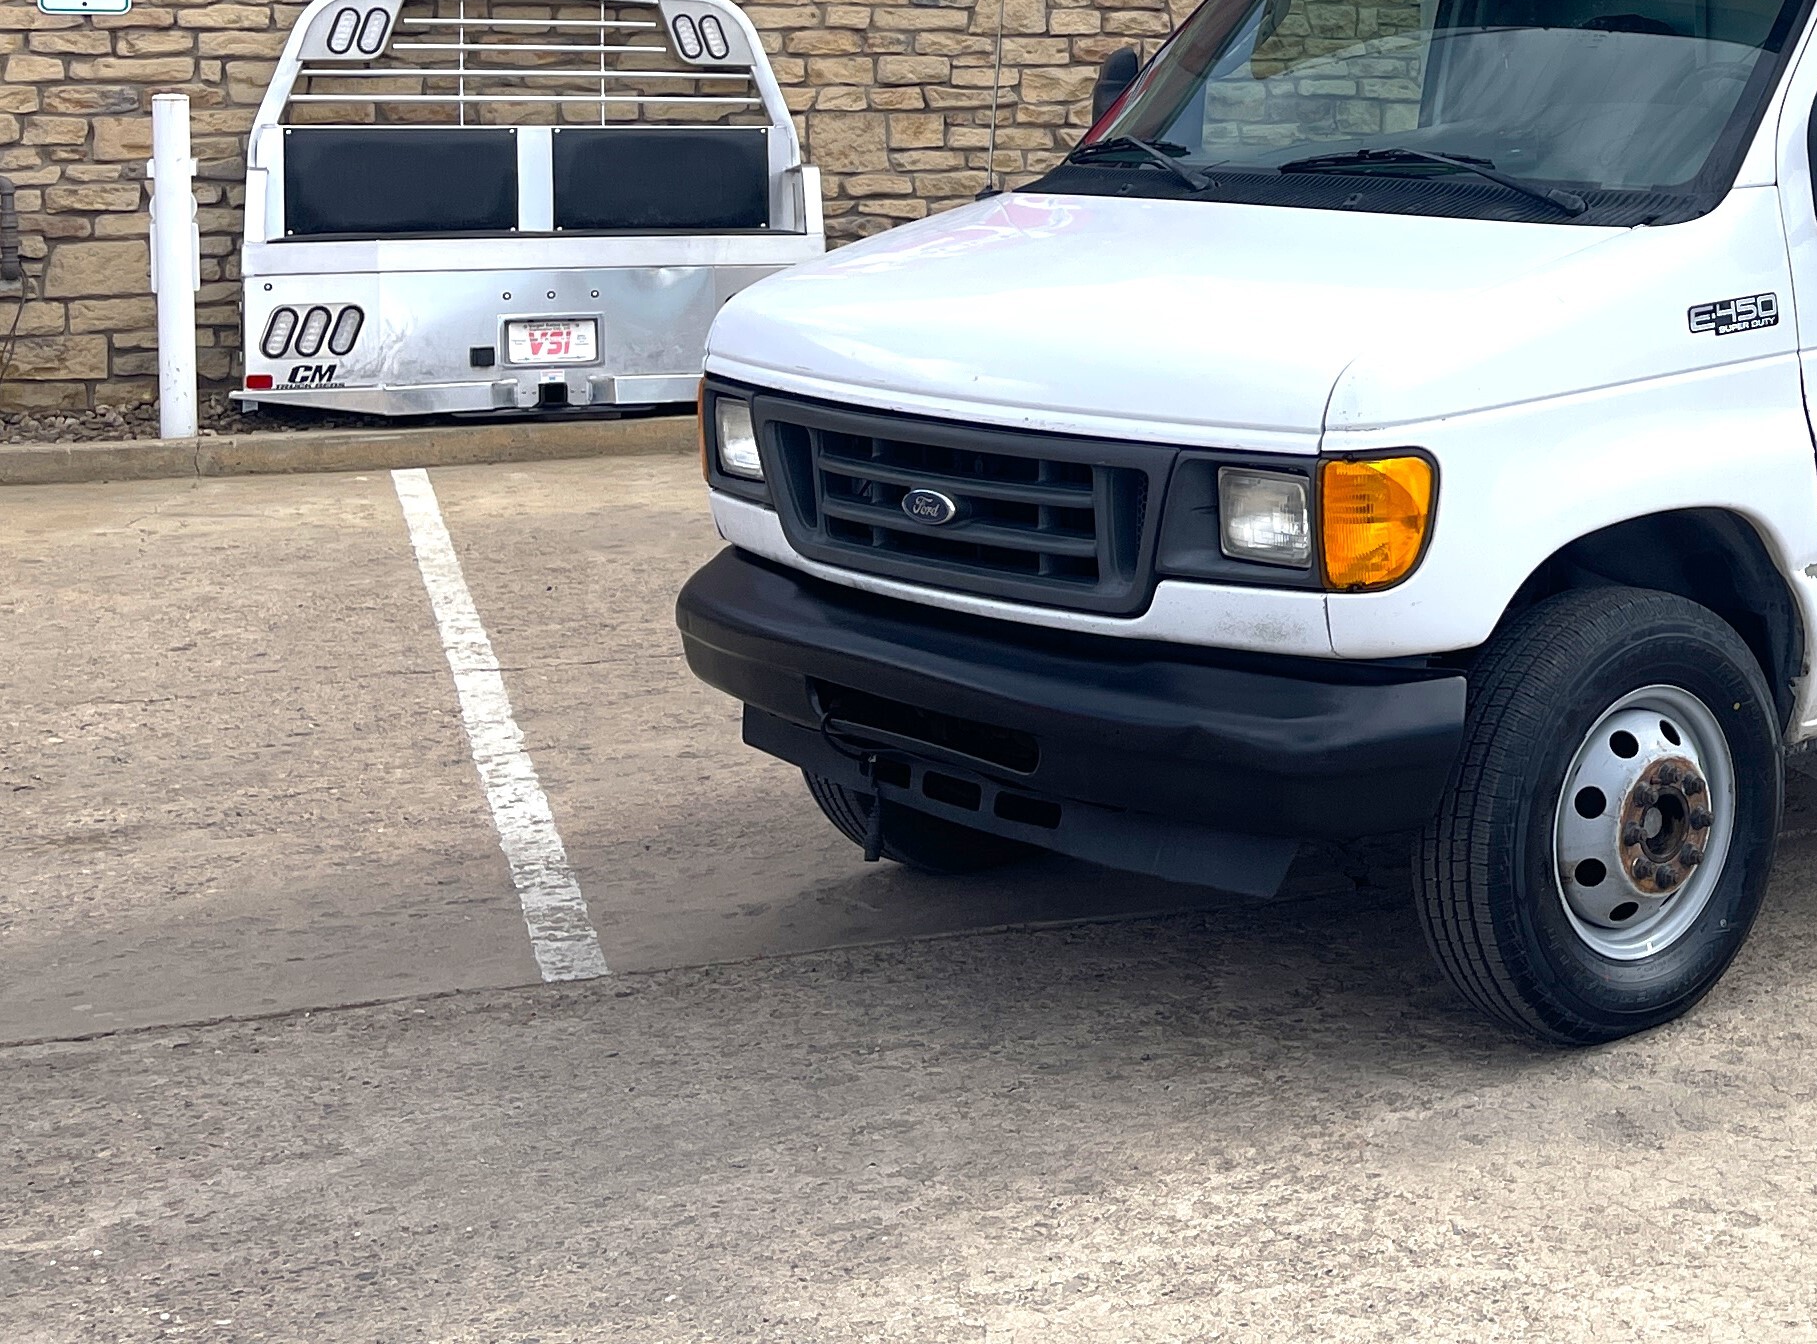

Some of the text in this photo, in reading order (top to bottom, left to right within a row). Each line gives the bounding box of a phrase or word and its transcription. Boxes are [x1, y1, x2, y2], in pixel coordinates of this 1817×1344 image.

[1689, 294, 1777, 332] E-450
[1718, 316, 1776, 334] SUPER DUTY
[528, 330, 572, 356] VSI
[288, 363, 337, 383] CM
[912, 495, 940, 517] Ford
